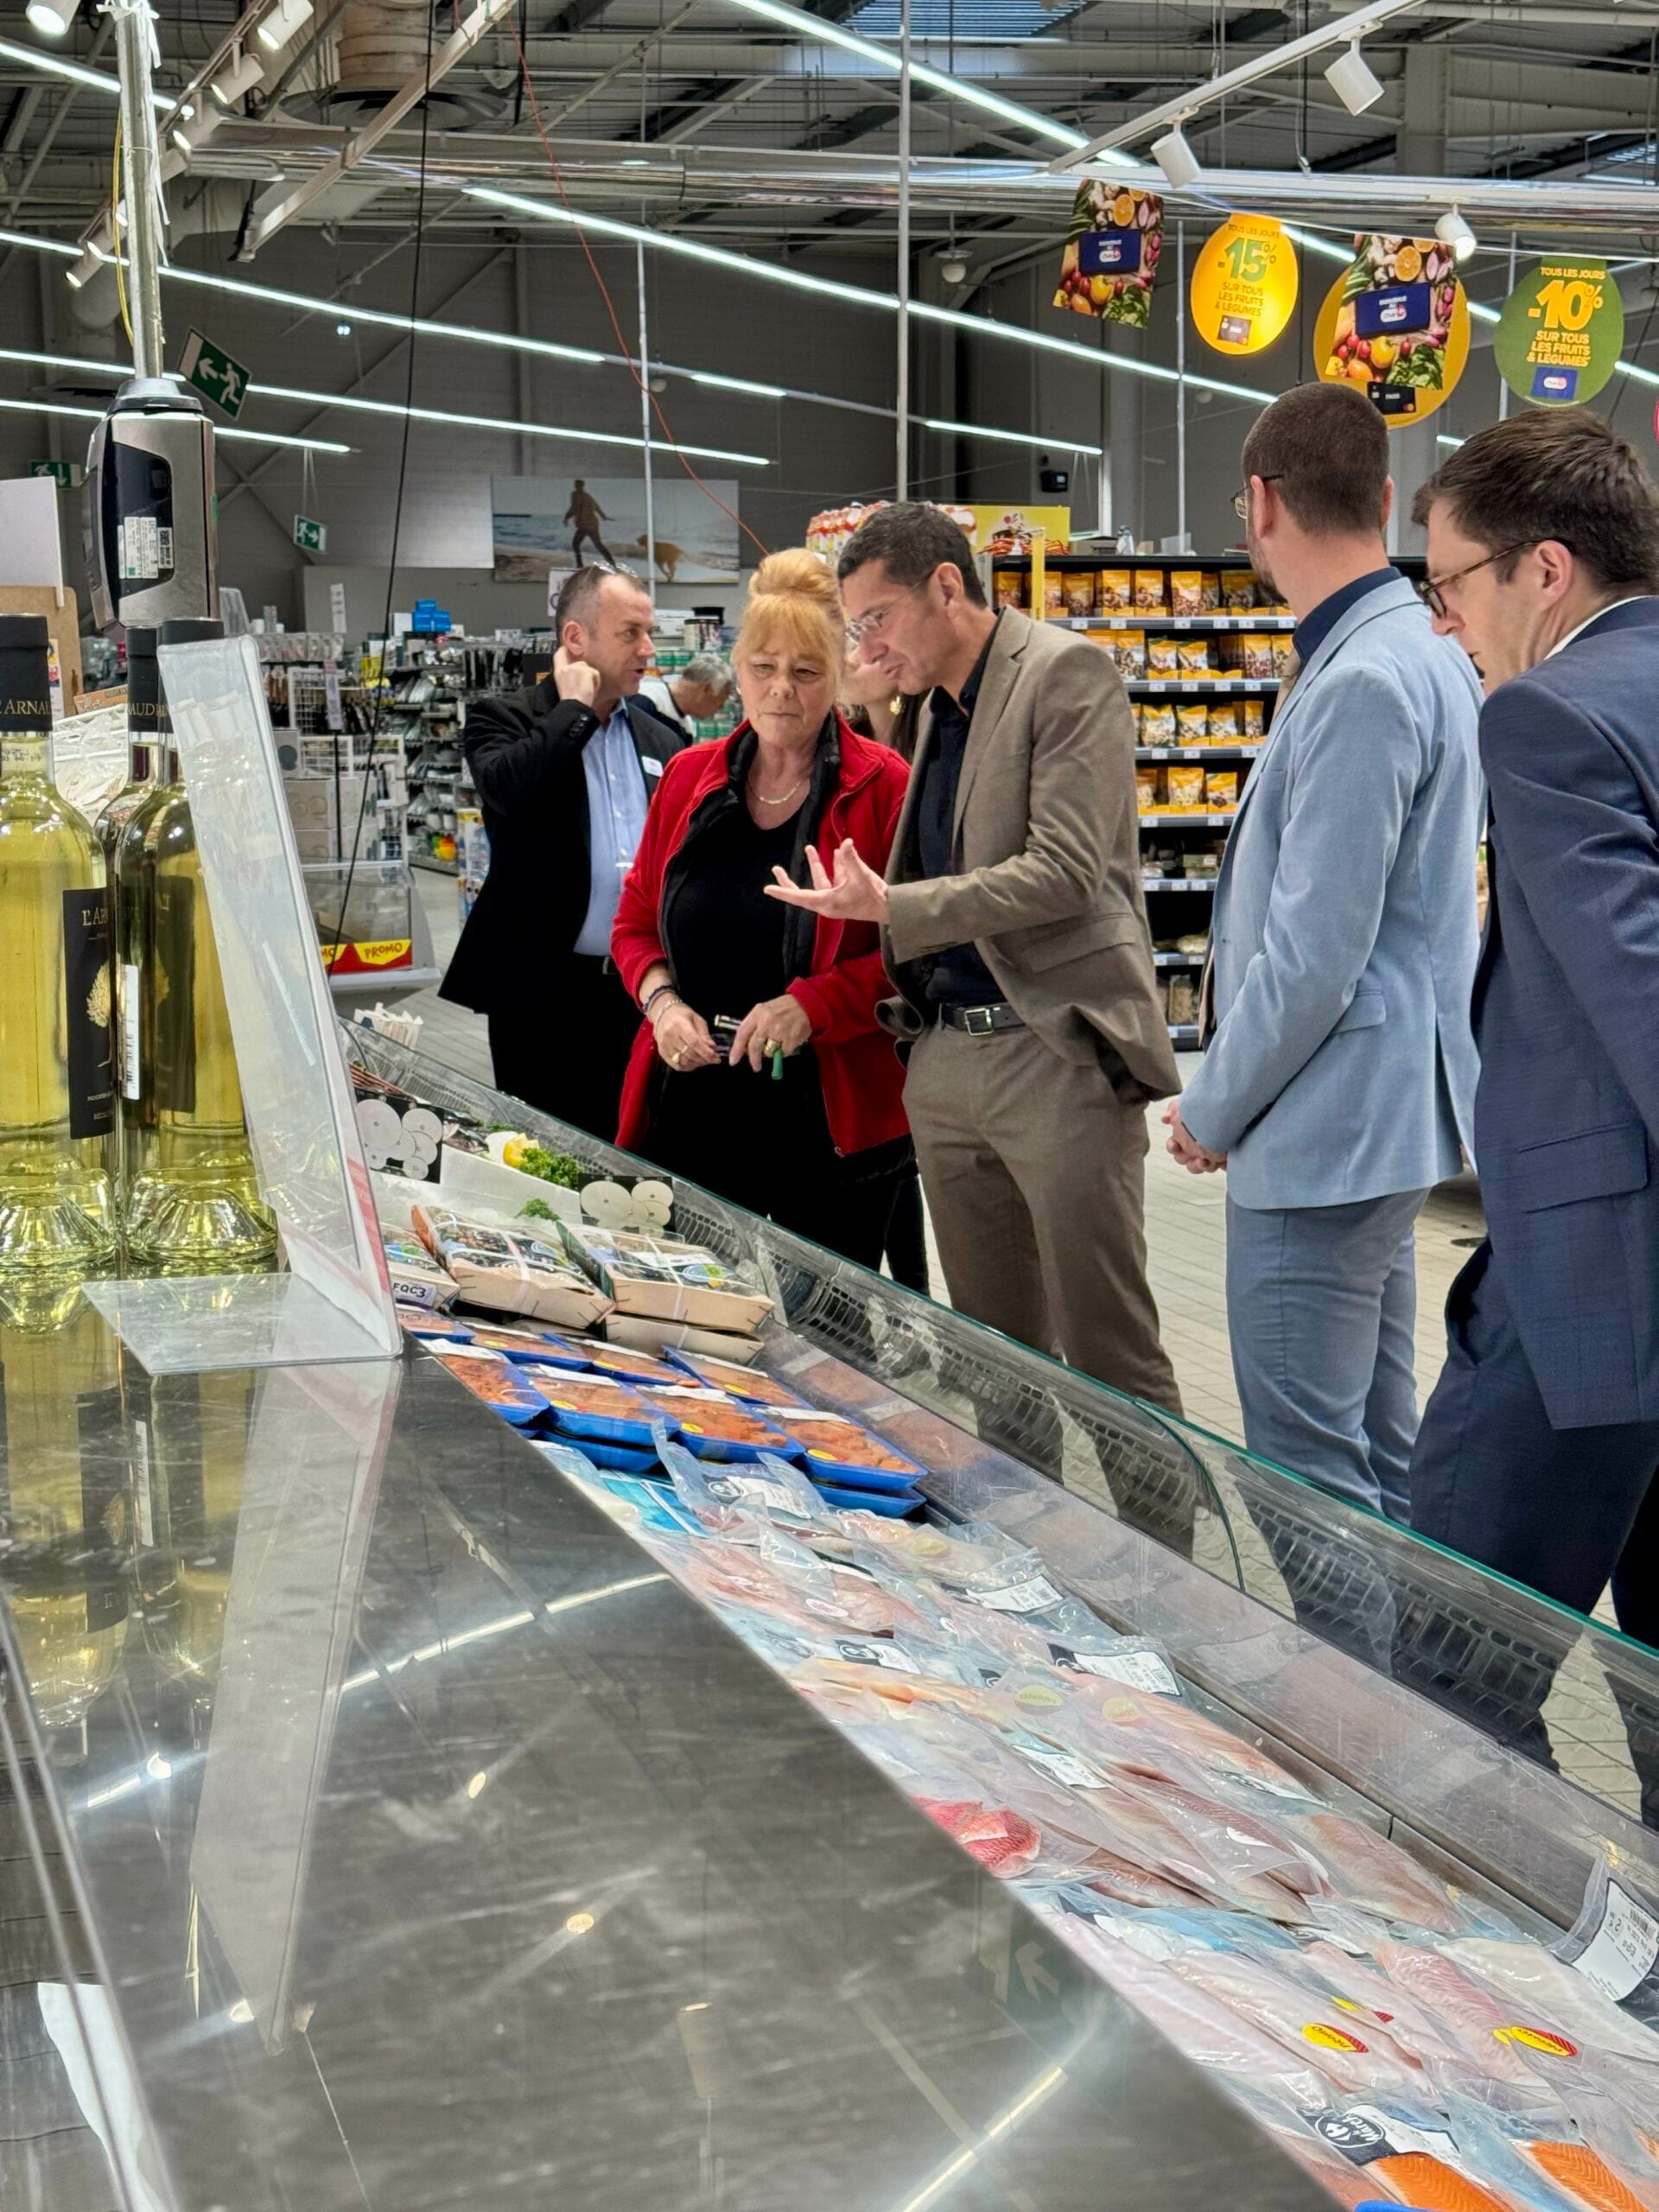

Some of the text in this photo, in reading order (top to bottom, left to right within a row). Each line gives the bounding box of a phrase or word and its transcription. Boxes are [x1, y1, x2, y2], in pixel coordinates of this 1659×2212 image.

[1540, 267, 1605, 280] TOUS LES JOURS
[1222, 282, 1263, 296] SUR TOUS
[1218, 291, 1264, 307] LES FRUITS
[1528, 279, 1604, 331] -10%
[1535, 330, 1589, 345] SUR TOUS
[1531, 341, 1591, 356] LES FRUITS
[364, 942, 404, 959] PROMO
[1341, 2114, 1382, 2142] March
